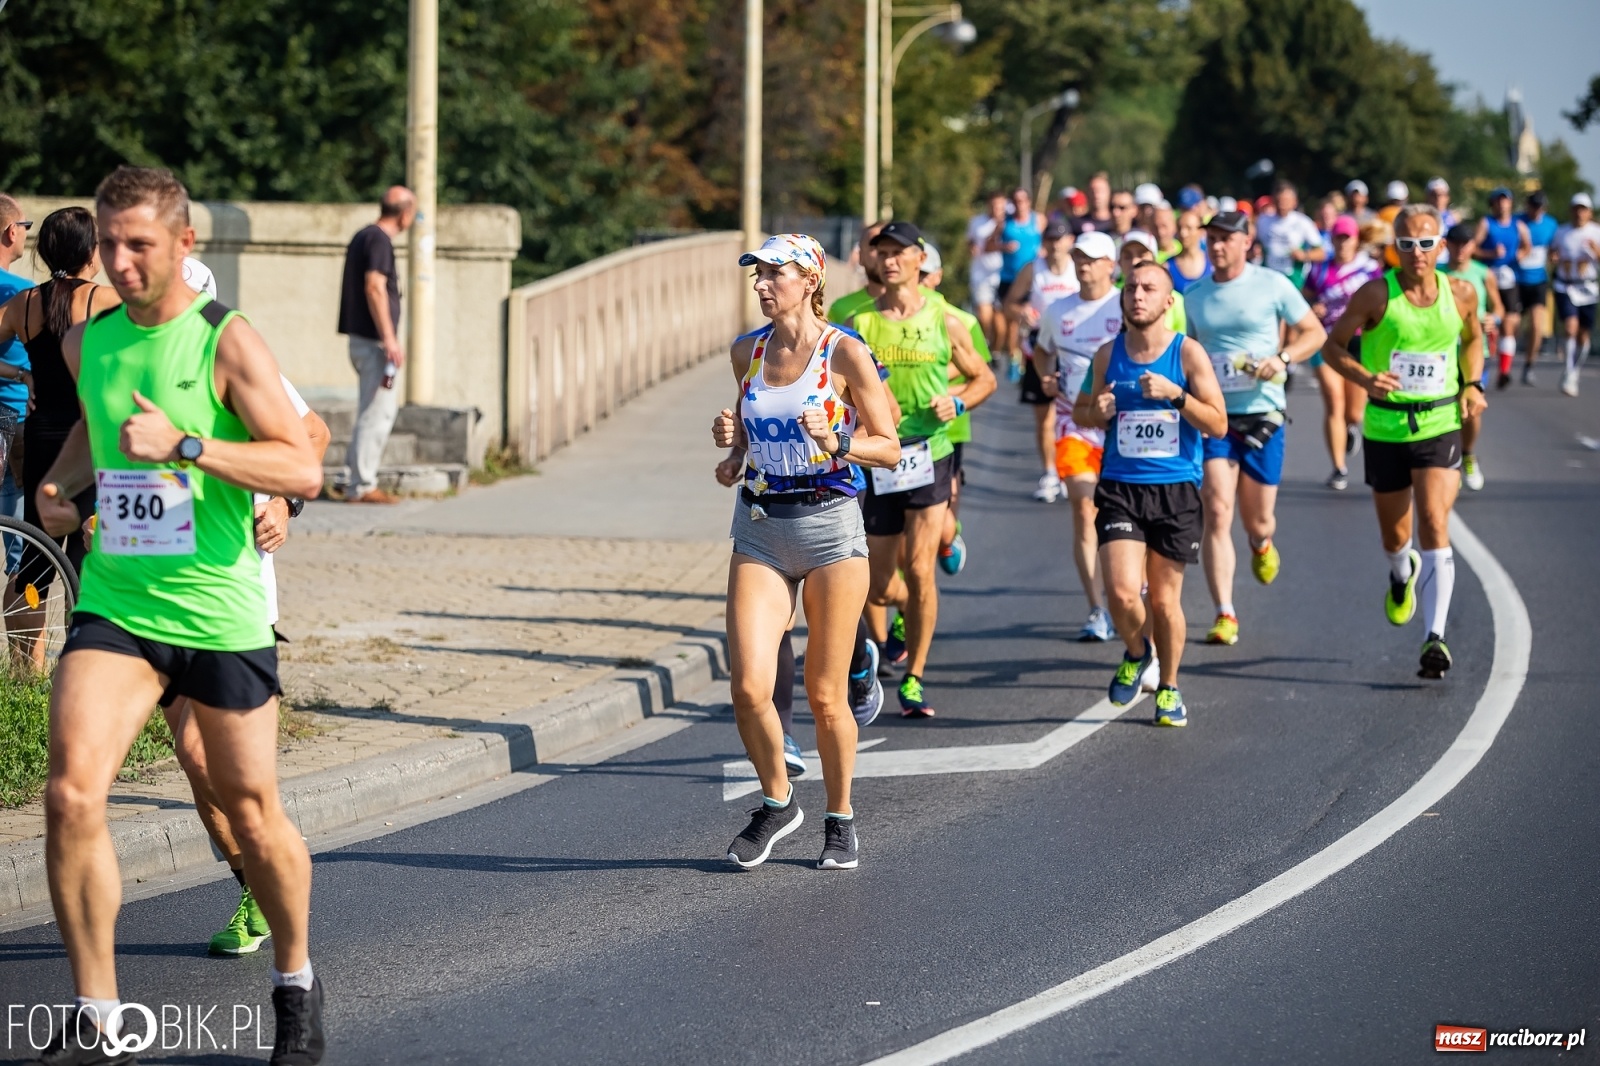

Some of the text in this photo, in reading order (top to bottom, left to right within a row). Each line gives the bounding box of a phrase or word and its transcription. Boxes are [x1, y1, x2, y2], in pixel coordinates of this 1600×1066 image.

[1408, 364, 1435, 377] 382
[744, 417, 806, 443] NOA
[1135, 424, 1165, 438] 206
[750, 443, 806, 463] RUN
[755, 463, 808, 475] OUR
[891, 456, 917, 473] 95
[117, 494, 164, 520] 360
